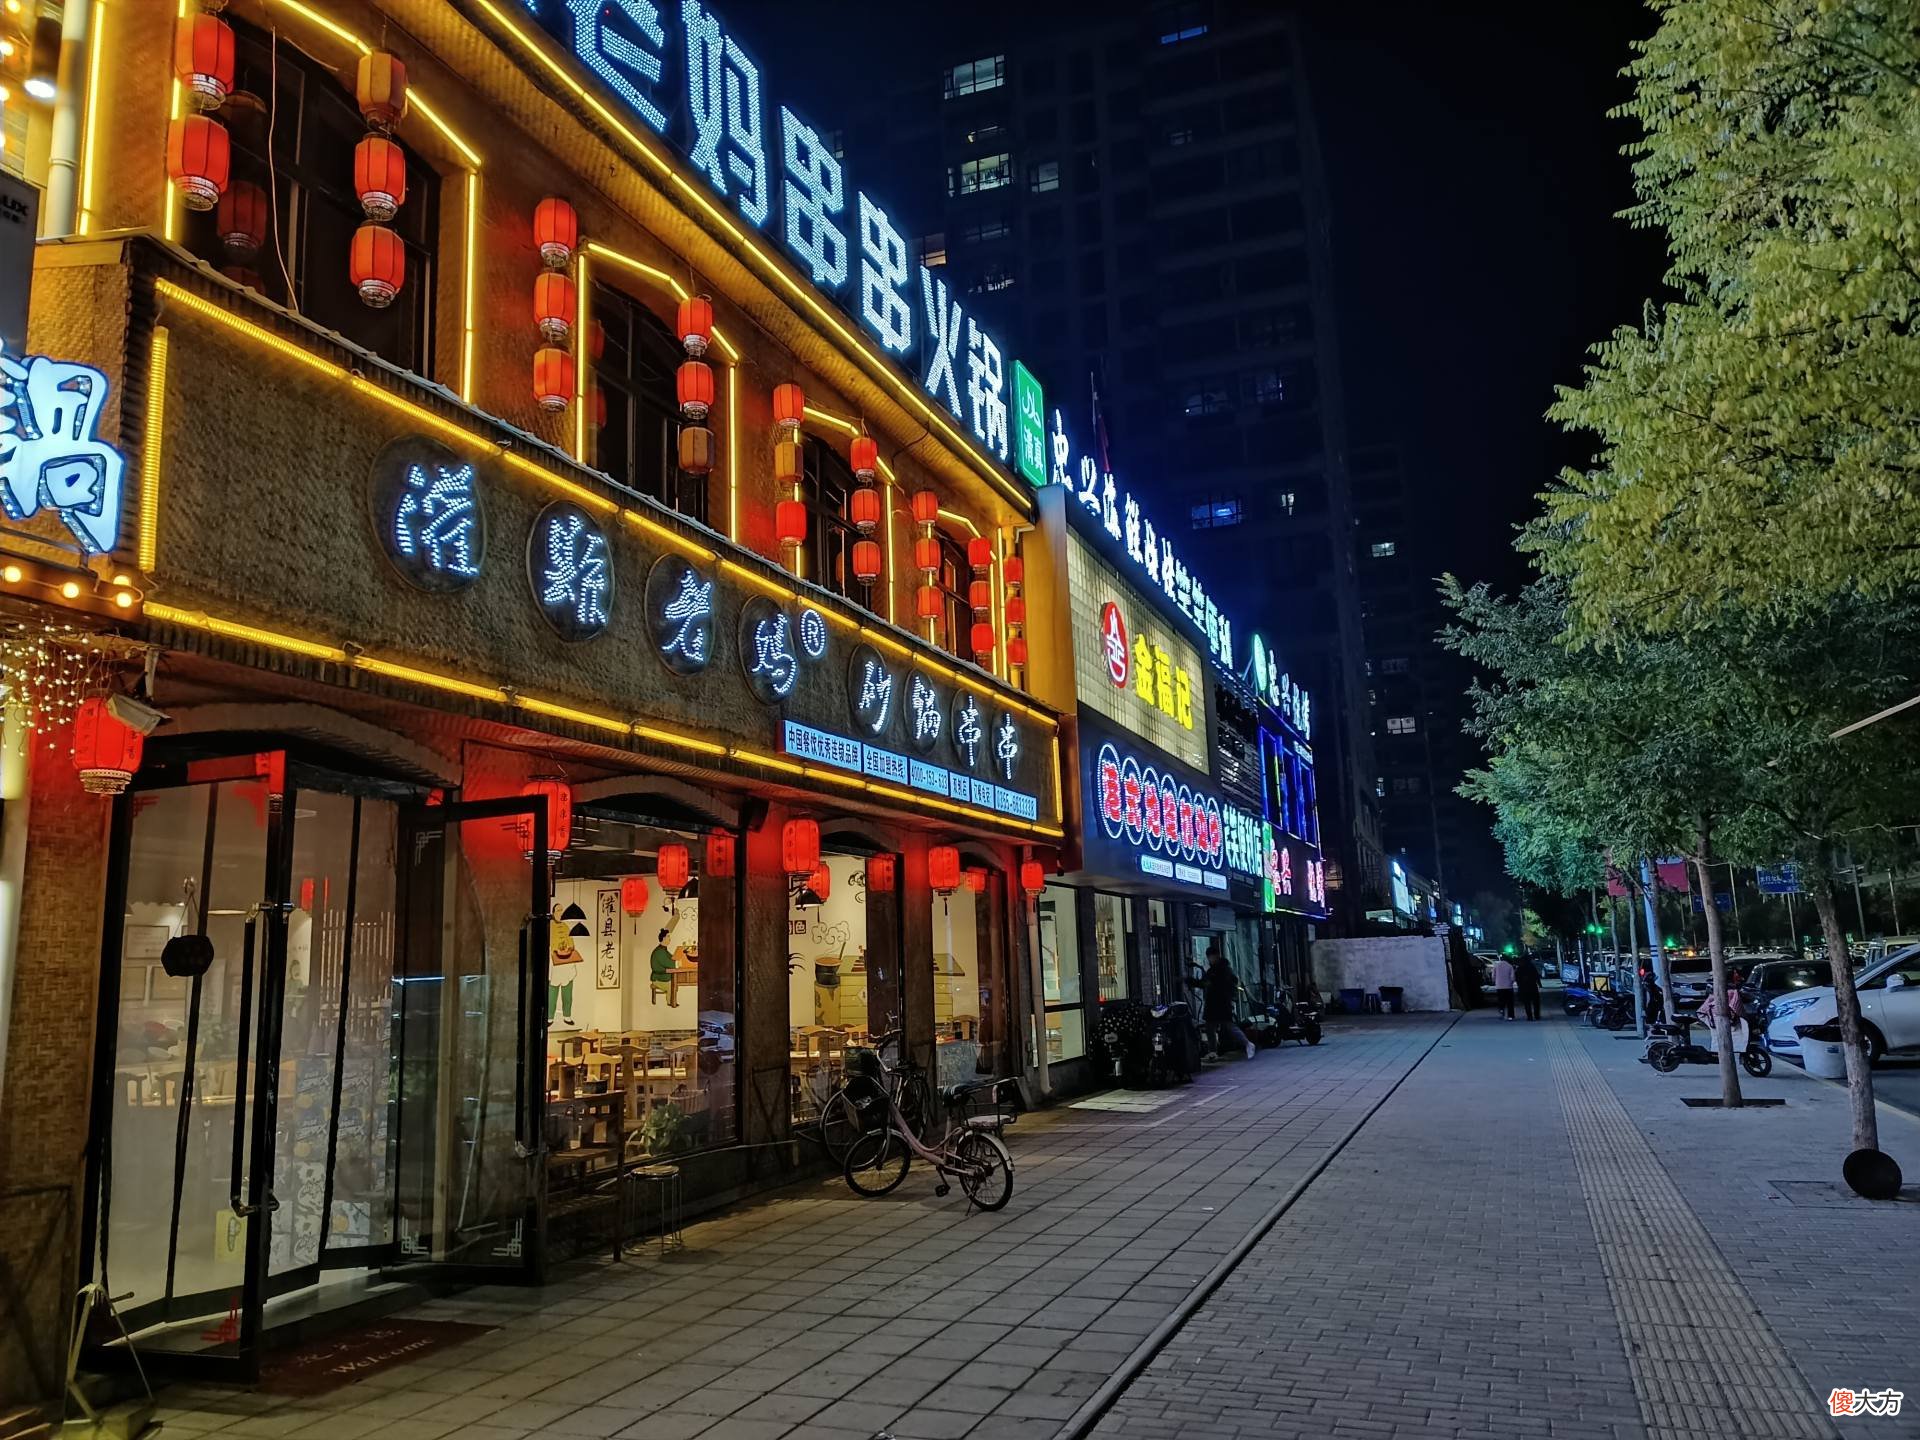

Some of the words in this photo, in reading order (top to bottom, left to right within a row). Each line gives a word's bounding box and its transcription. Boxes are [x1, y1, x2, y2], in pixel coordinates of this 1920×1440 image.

[788, 726, 859, 767] 中国餐饮优秀连锁品牌
[866, 751, 906, 779] 全国加盟热线
[601, 896, 616, 980] 灌县老妈
